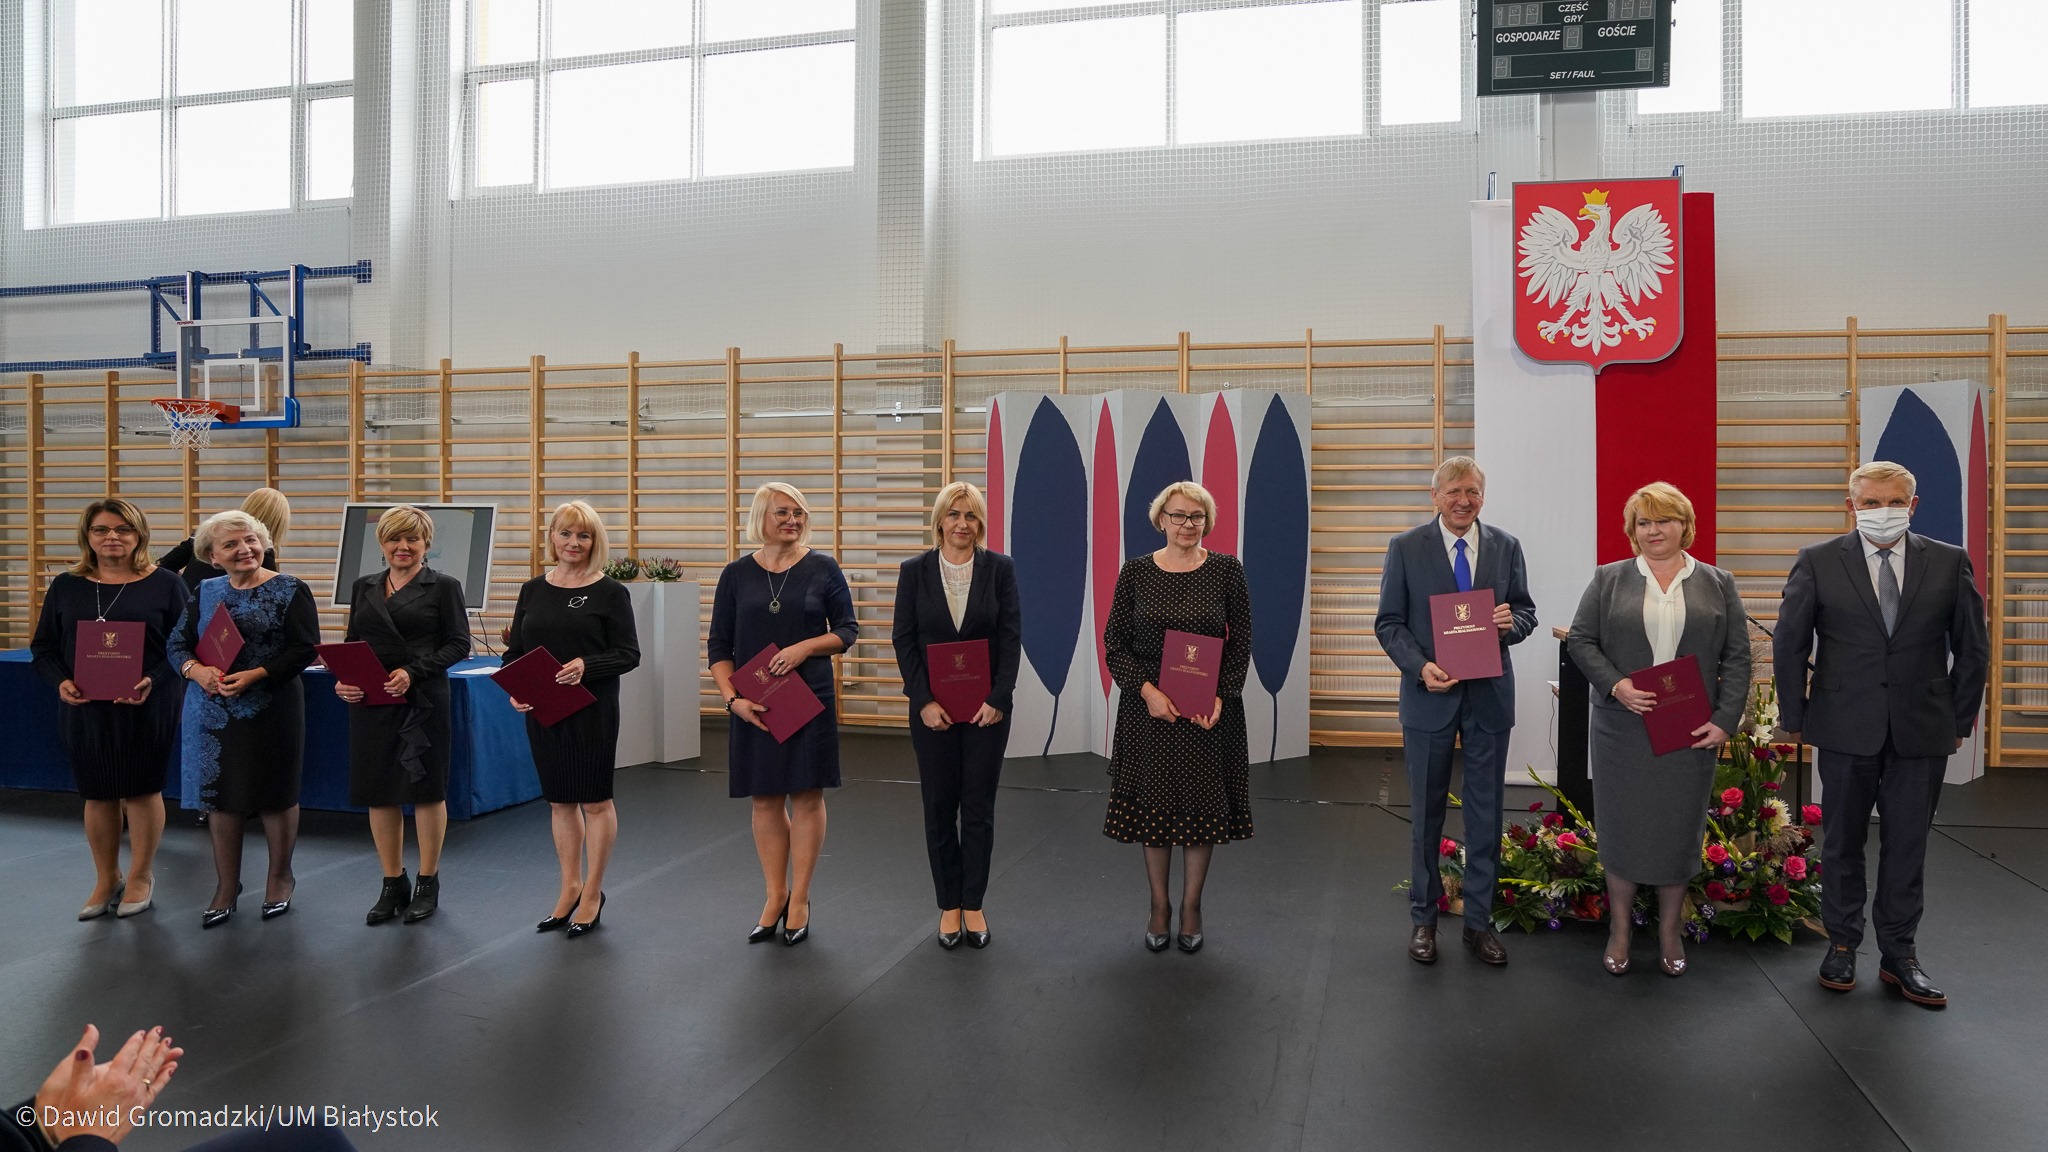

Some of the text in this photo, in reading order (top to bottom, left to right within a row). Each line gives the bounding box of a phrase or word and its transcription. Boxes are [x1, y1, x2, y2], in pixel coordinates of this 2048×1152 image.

[1558, 3, 1589, 13] CZĘŚĆ
[1563, 14, 1584, 23] GRY
[1495, 29, 1561, 43] GOSPODARZE
[1597, 23, 1637, 38] GOŚCIE
